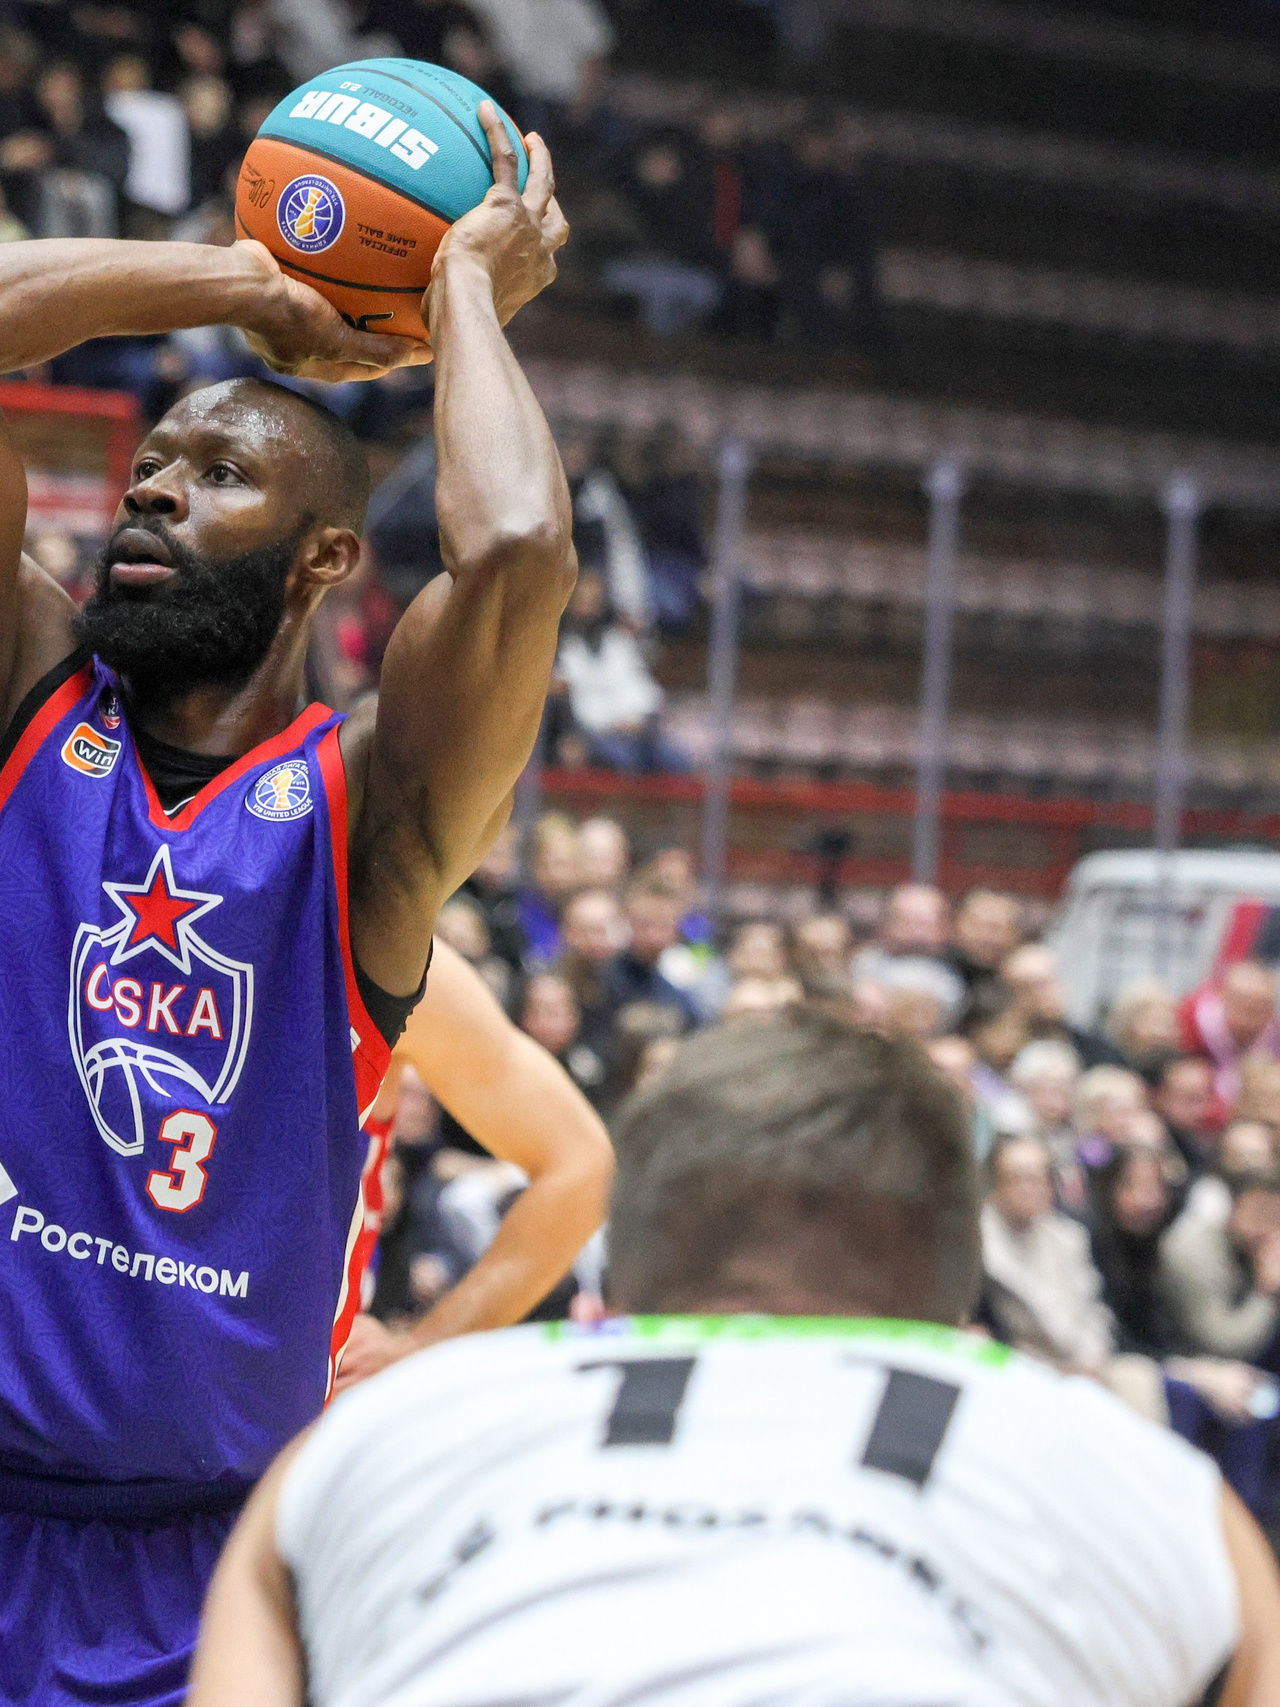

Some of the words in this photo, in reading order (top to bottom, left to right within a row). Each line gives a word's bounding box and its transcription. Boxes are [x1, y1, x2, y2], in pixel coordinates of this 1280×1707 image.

[339, 80, 362, 92] 2.0
[289, 90, 439, 171] SIBUR
[356, 222, 385, 240] BALL
[386, 232, 417, 249] GAME
[359, 236, 408, 259] OFFICIAL
[252, 803, 263, 814] VTB
[263, 809, 290, 818] UNITED
[290, 797, 313, 816] LEAGUE
[85, 961, 224, 1040] CSKA
[145, 1107, 218, 1213] 3
[10, 1204, 250, 1299] Ростелеком
